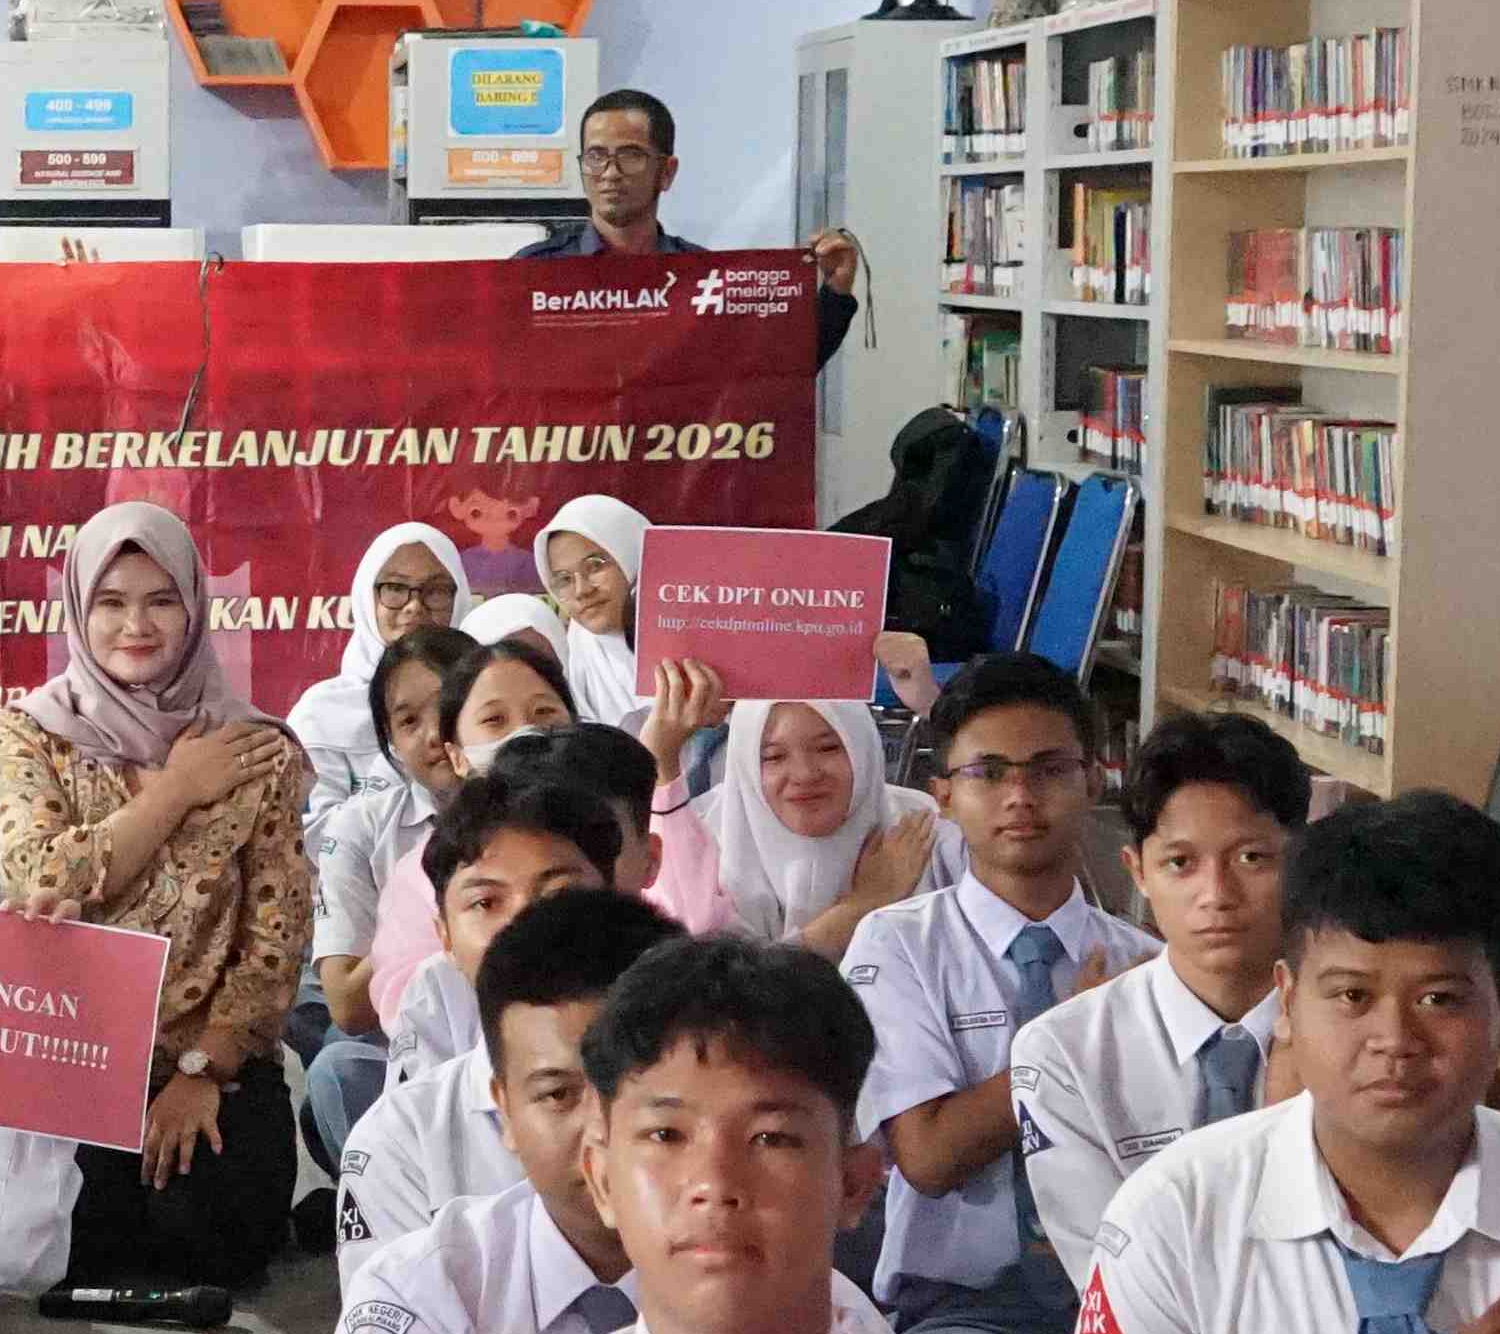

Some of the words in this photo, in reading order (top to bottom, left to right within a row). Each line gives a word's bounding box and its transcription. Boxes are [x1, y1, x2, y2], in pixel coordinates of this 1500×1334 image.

[47, 153, 72, 165] 500
[725, 269, 790, 286] bangga
[531, 289, 670, 312] BerAKHLAK
[725, 282, 803, 301] melayani
[725, 300, 789, 318] bangsa
[48, 425, 459, 471] BERKELANJUTAN
[471, 424, 635, 464] TAHUN
[643, 421, 775, 462] 2026
[657, 582, 710, 606] CEK
[716, 585, 766, 607] DPT
[771, 586, 866, 609] ONLINE
[342, 1208, 358, 1225] XI
[1087, 1292, 1101, 1310] XI
[1083, 1313, 1107, 1334] AK
